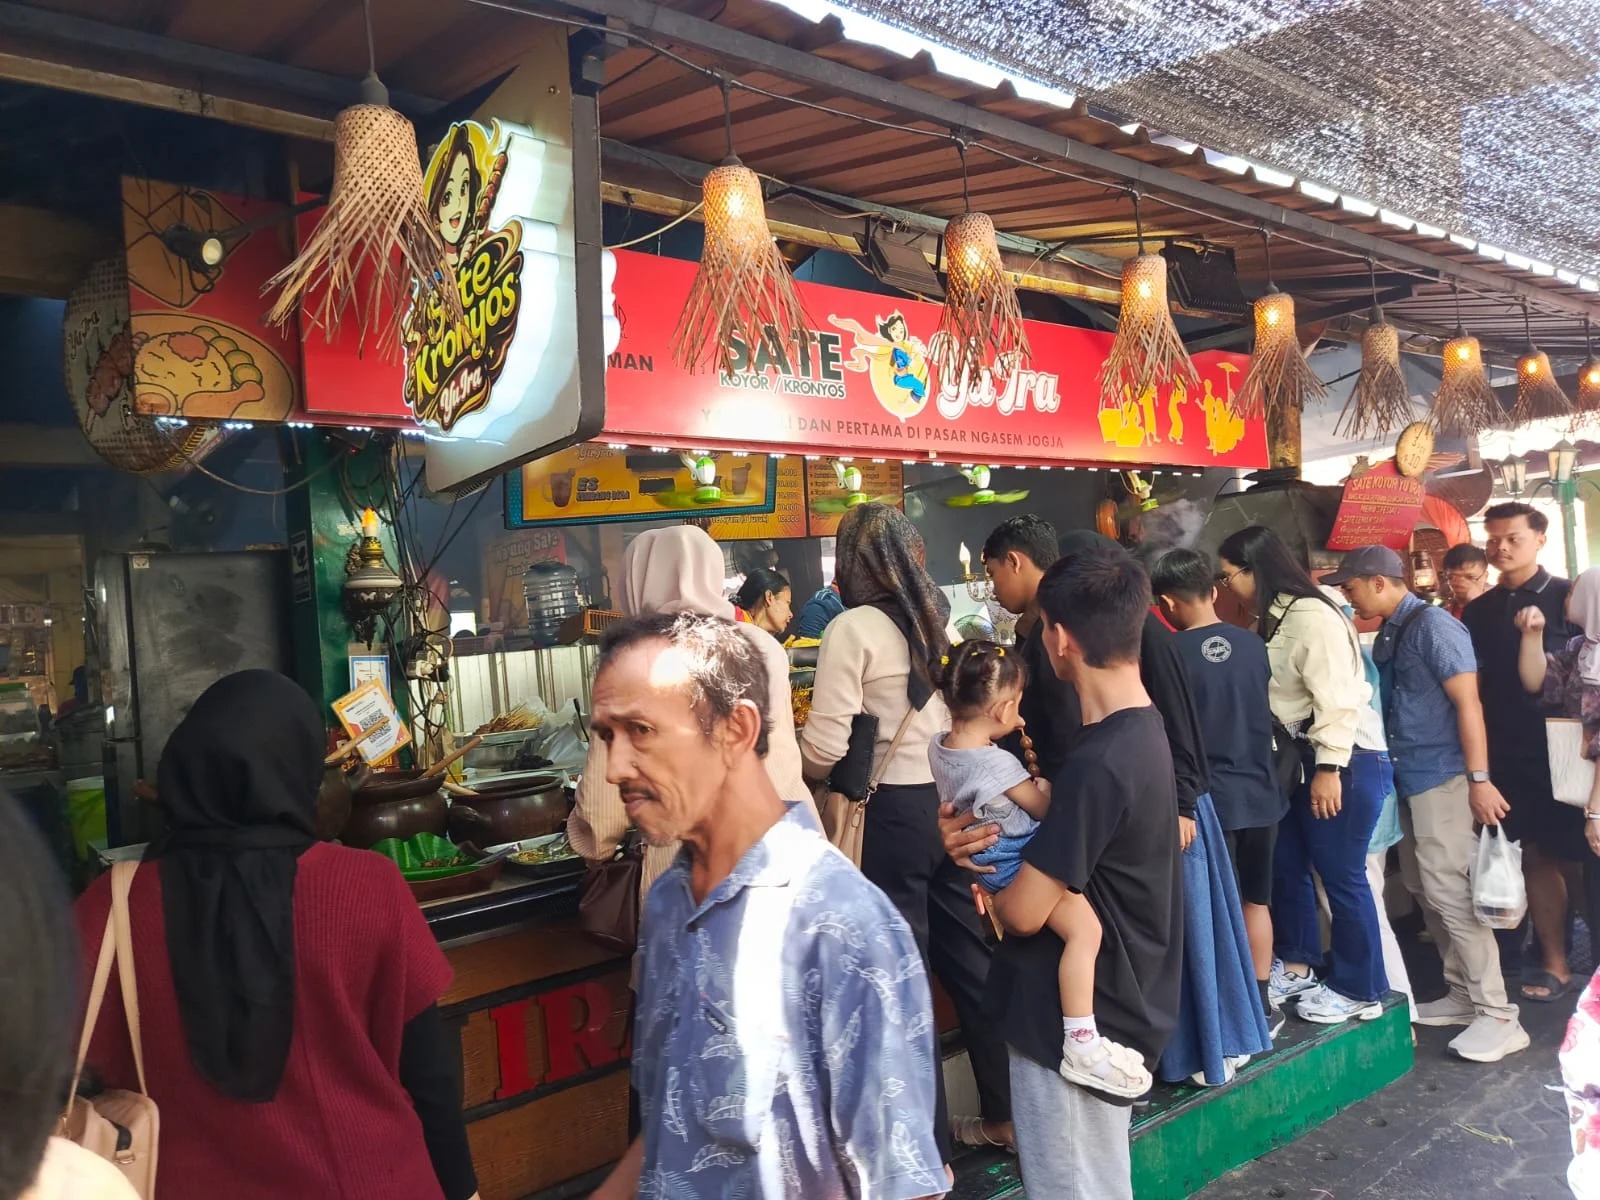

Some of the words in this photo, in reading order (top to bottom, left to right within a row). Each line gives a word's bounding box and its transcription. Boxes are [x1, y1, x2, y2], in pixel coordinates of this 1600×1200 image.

[426, 251, 491, 344] Ste
[415, 271, 517, 404] Kronyos
[721, 325, 843, 382] SATE
[720, 372, 769, 390] KOYOR
[783, 378, 846, 398] KRONYOS
[798, 417, 832, 434] DAN
[837, 422, 902, 439] PERTAMA
[906, 426, 921, 440] DI
[925, 427, 967, 443] PASAR
[971, 432, 1023, 447] NGASEM
[1027, 435, 1064, 449] JOGJA
[490, 981, 631, 1101] IR
